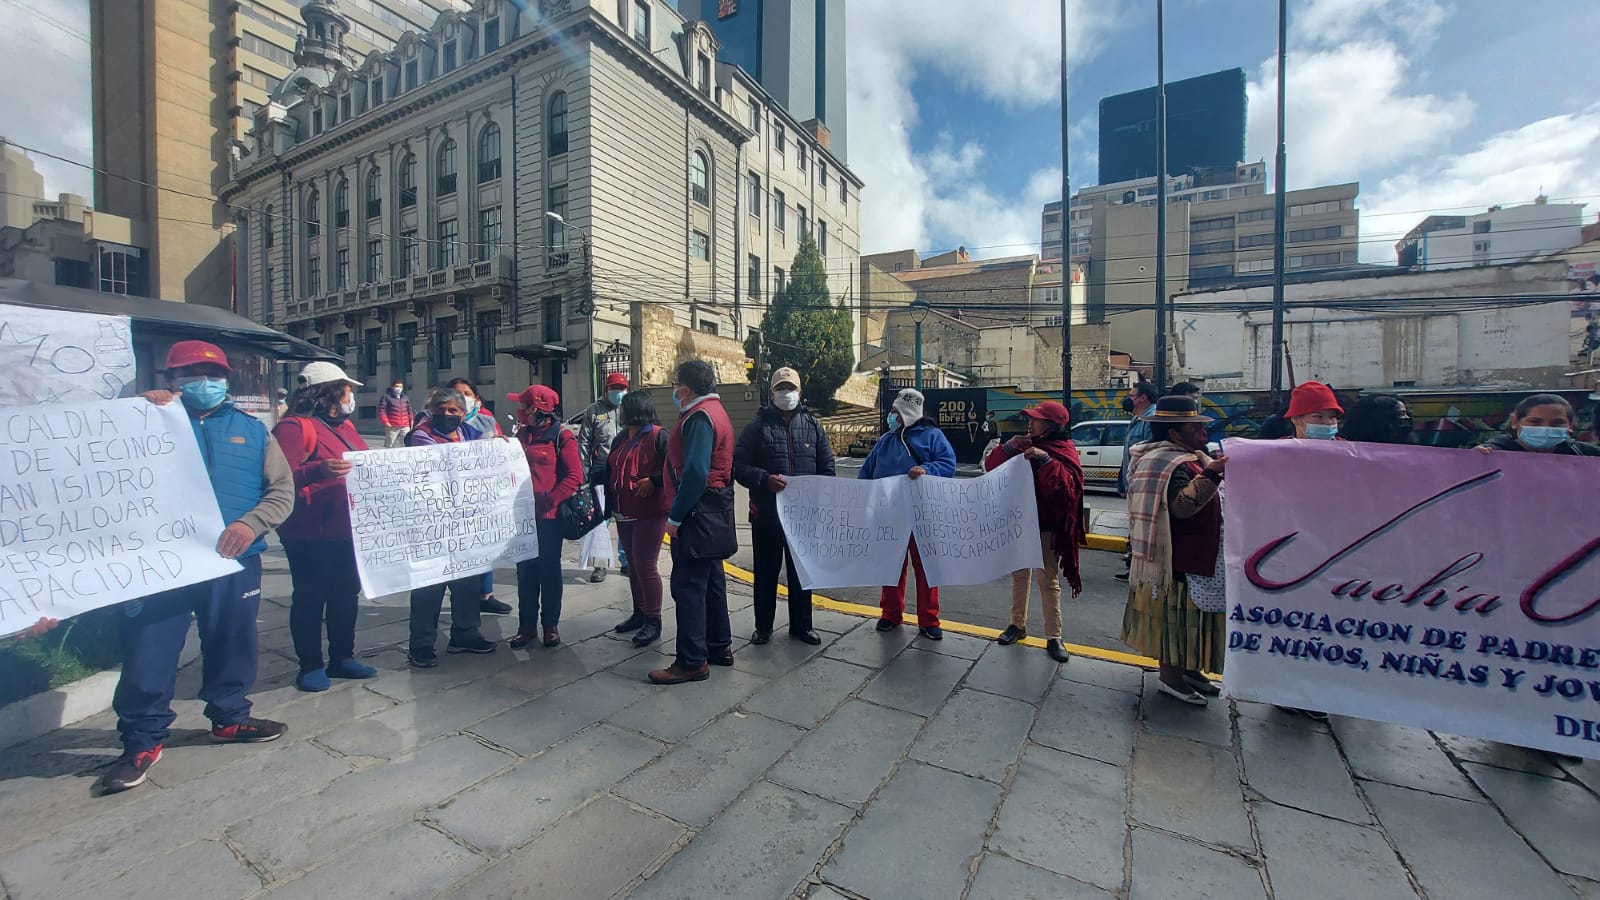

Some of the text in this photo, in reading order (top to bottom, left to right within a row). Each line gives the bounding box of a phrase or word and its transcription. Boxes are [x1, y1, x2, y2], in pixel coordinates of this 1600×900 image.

[132, 403, 151, 431] Y
[939, 401, 966, 412] 200
[11, 431, 176, 475] DE VECINOS
[354, 465, 394, 481] JUNTA
[410, 459, 453, 474] VECINOS
[53, 466, 155, 505] ISIDRO
[441, 480, 460, 497] NO
[0, 496, 160, 547] DESALOJAR
[357, 506, 403, 522] PARA
[783, 505, 857, 527] PEDIMOS EL
[912, 500, 999, 524] DERECHOS DE
[155, 514, 197, 543] CON
[354, 521, 387, 535] CON
[448, 537, 466, 554] DE
[470, 519, 536, 550] ACUERDOS
[876, 526, 899, 542] DEL
[915, 522, 975, 541] NUESTROS
[938, 522, 1024, 559] DISCAPACIDAD
[1229, 603, 1413, 642] ASOCIACION
[1421, 627, 1467, 650] DE
[1229, 631, 1263, 653] DE
[1268, 636, 1369, 671] NIÑOS,
[1379, 652, 1489, 685] NIÑAS
[1499, 668, 1525, 690] Y
